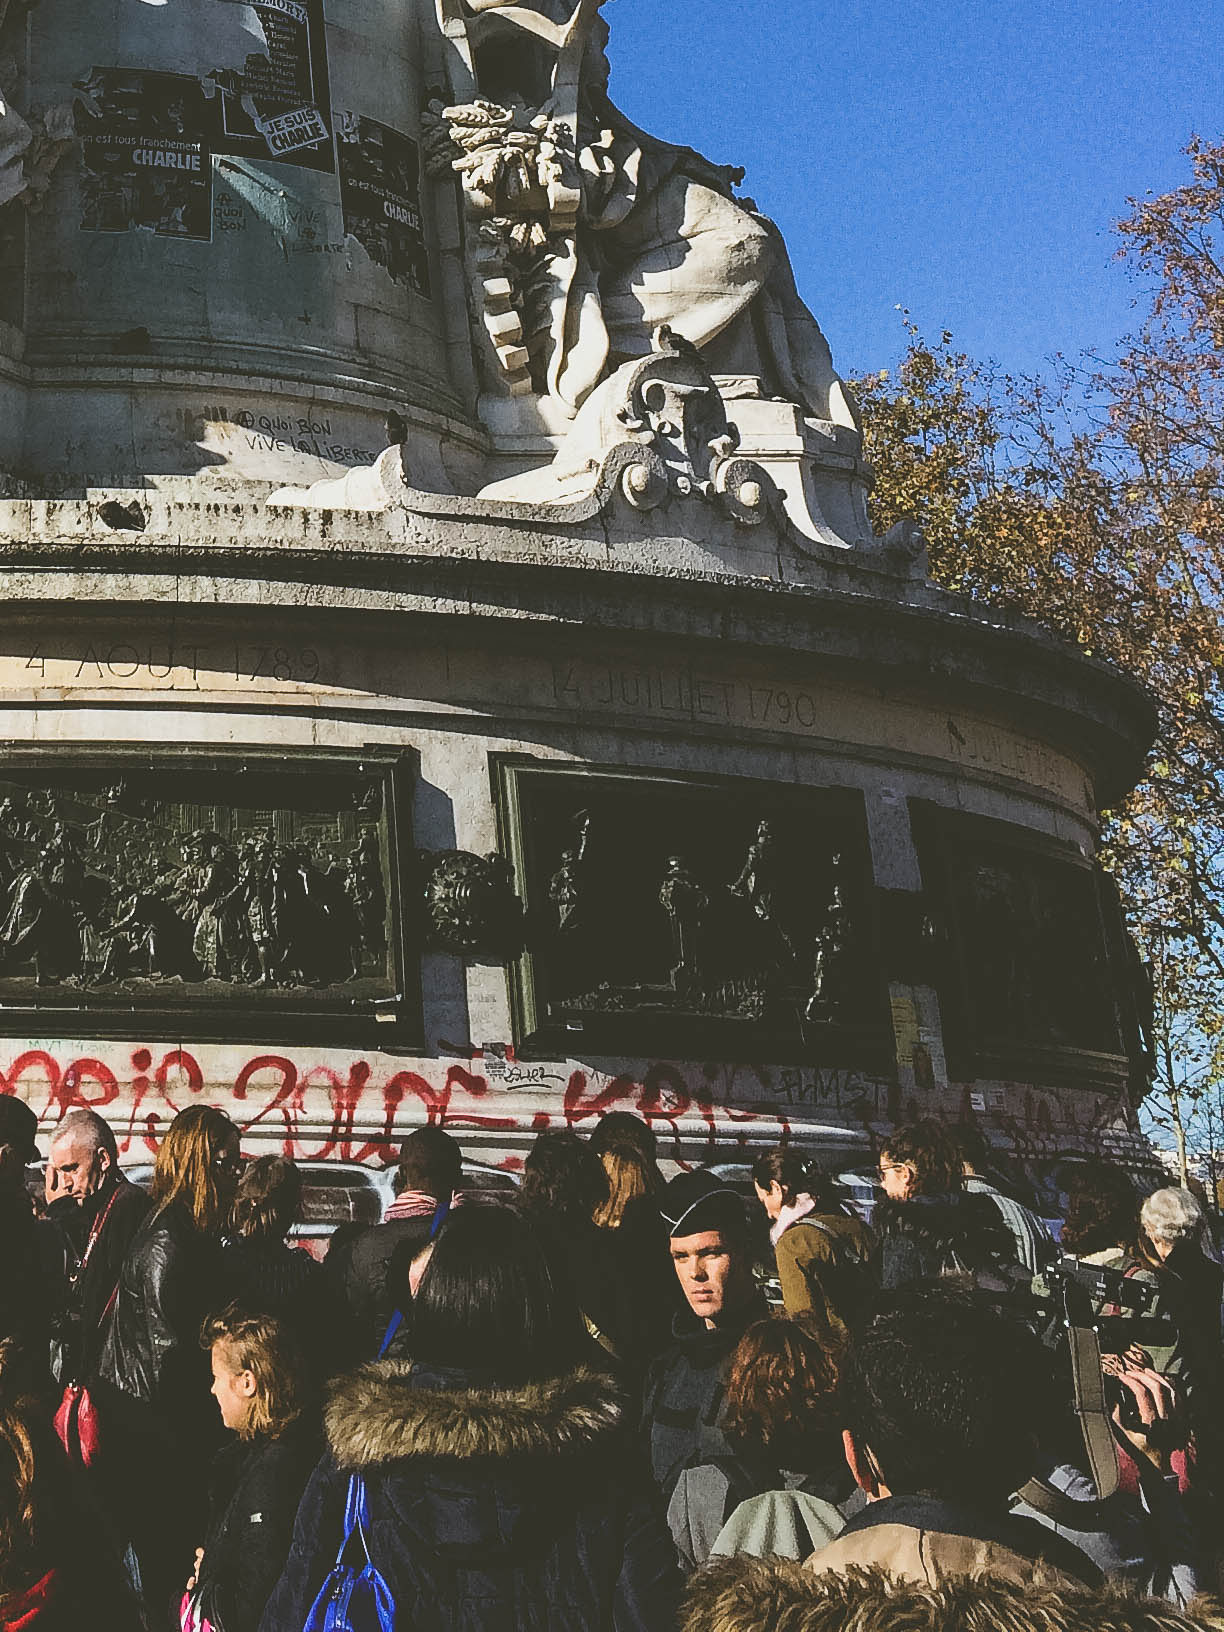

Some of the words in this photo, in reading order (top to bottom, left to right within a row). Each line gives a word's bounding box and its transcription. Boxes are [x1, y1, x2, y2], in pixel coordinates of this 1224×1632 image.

[267, 119, 285, 135] JE
[286, 108, 316, 128] SUIS
[116, 135, 137, 145] tous
[139, 135, 201, 152] franchement
[271, 121, 323, 151] CHARLIE
[132, 148, 201, 171] CHARLIE
[383, 200, 420, 231] CHARLIE
[296, 418, 332, 436] BON
[25, 642, 45, 679] 4
[233, 640, 321, 683] 1789
[552, 662, 580, 700] 14
[599, 666, 736, 718] JUILLET
[746, 686, 817, 728] 1790
